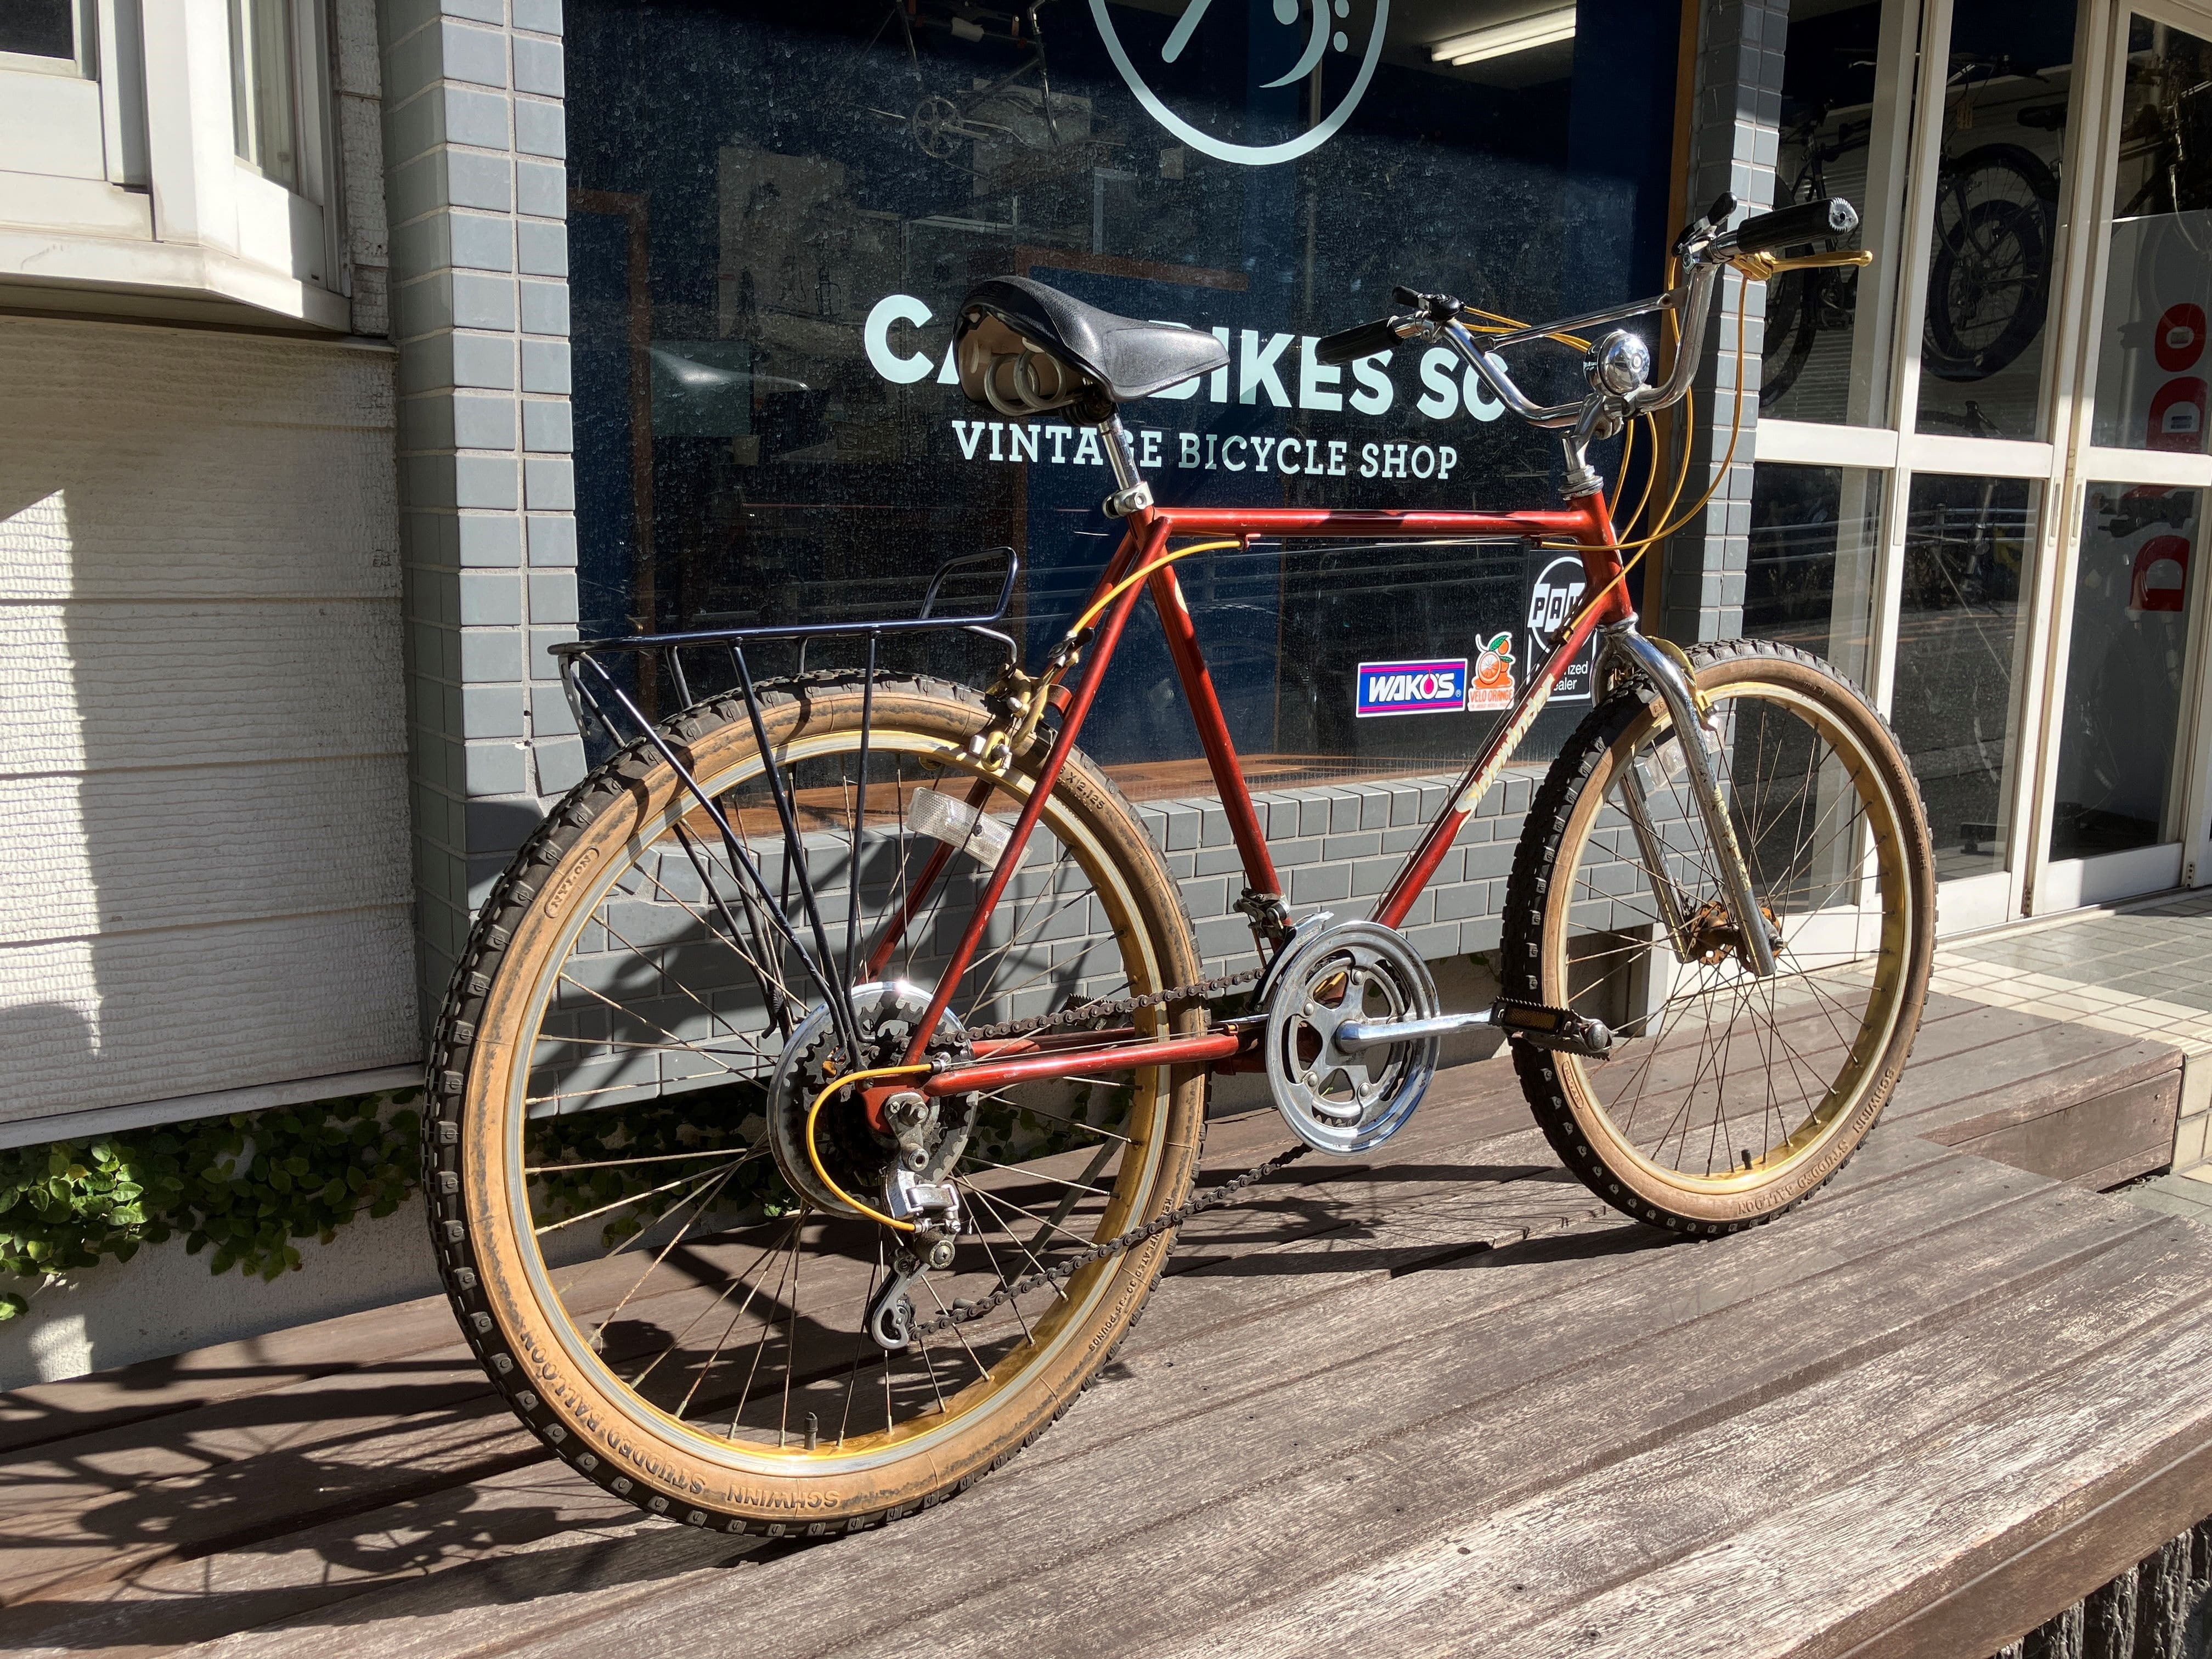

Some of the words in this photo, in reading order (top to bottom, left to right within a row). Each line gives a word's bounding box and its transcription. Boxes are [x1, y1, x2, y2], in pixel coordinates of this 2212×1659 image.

[1149, 320, 1393, 415] IKES
[1178, 433, 1346, 476] BICYCLE
[1360, 443, 1457, 479] SHOP
[2130, 303, 2207, 612] DDO
[1368, 672, 1455, 703] WAKO'S
[1470, 690, 1487, 703] VELO
[1488, 689, 1513, 702] ORANGE
[1553, 676, 1578, 691] ealer
[550, 854, 592, 909] NYLON
[1852, 1066, 1896, 1135] SCHWINN
[1797, 1139, 1849, 1189] STUDDED
[1737, 1183, 1796, 1215] BALLOON
[1135, 1233, 1163, 1278] NFLATED
[1088, 1315, 1118, 1352] POUNDS
[521, 1331, 605, 1432] BALLOON
[607, 1427, 707, 1494] STUDDED
[727, 1483, 840, 1509] SCHWINN
